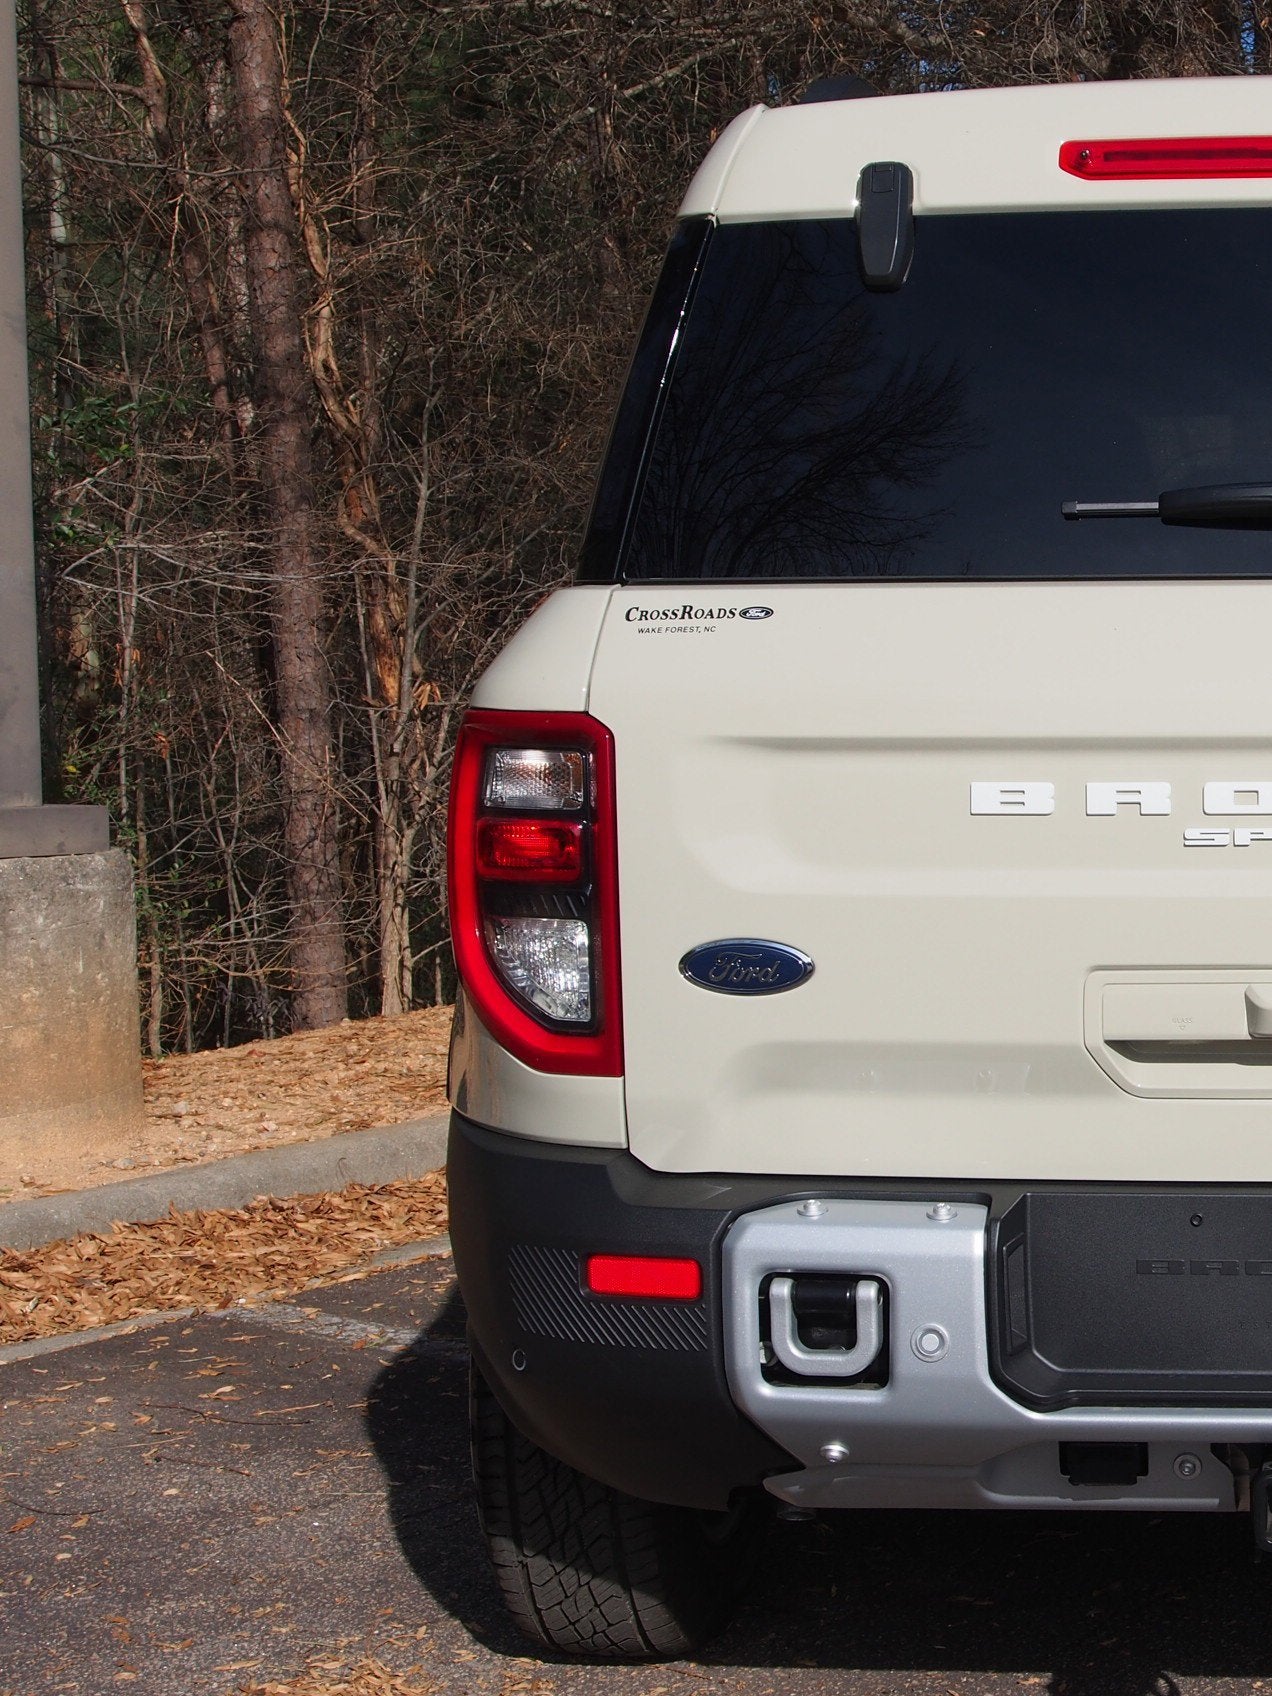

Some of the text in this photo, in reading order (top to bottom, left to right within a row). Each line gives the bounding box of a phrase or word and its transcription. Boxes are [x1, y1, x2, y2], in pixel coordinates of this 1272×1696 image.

[638, 625, 717, 634] WAKE FOREST, NC
[708, 951, 782, 983] Ford
